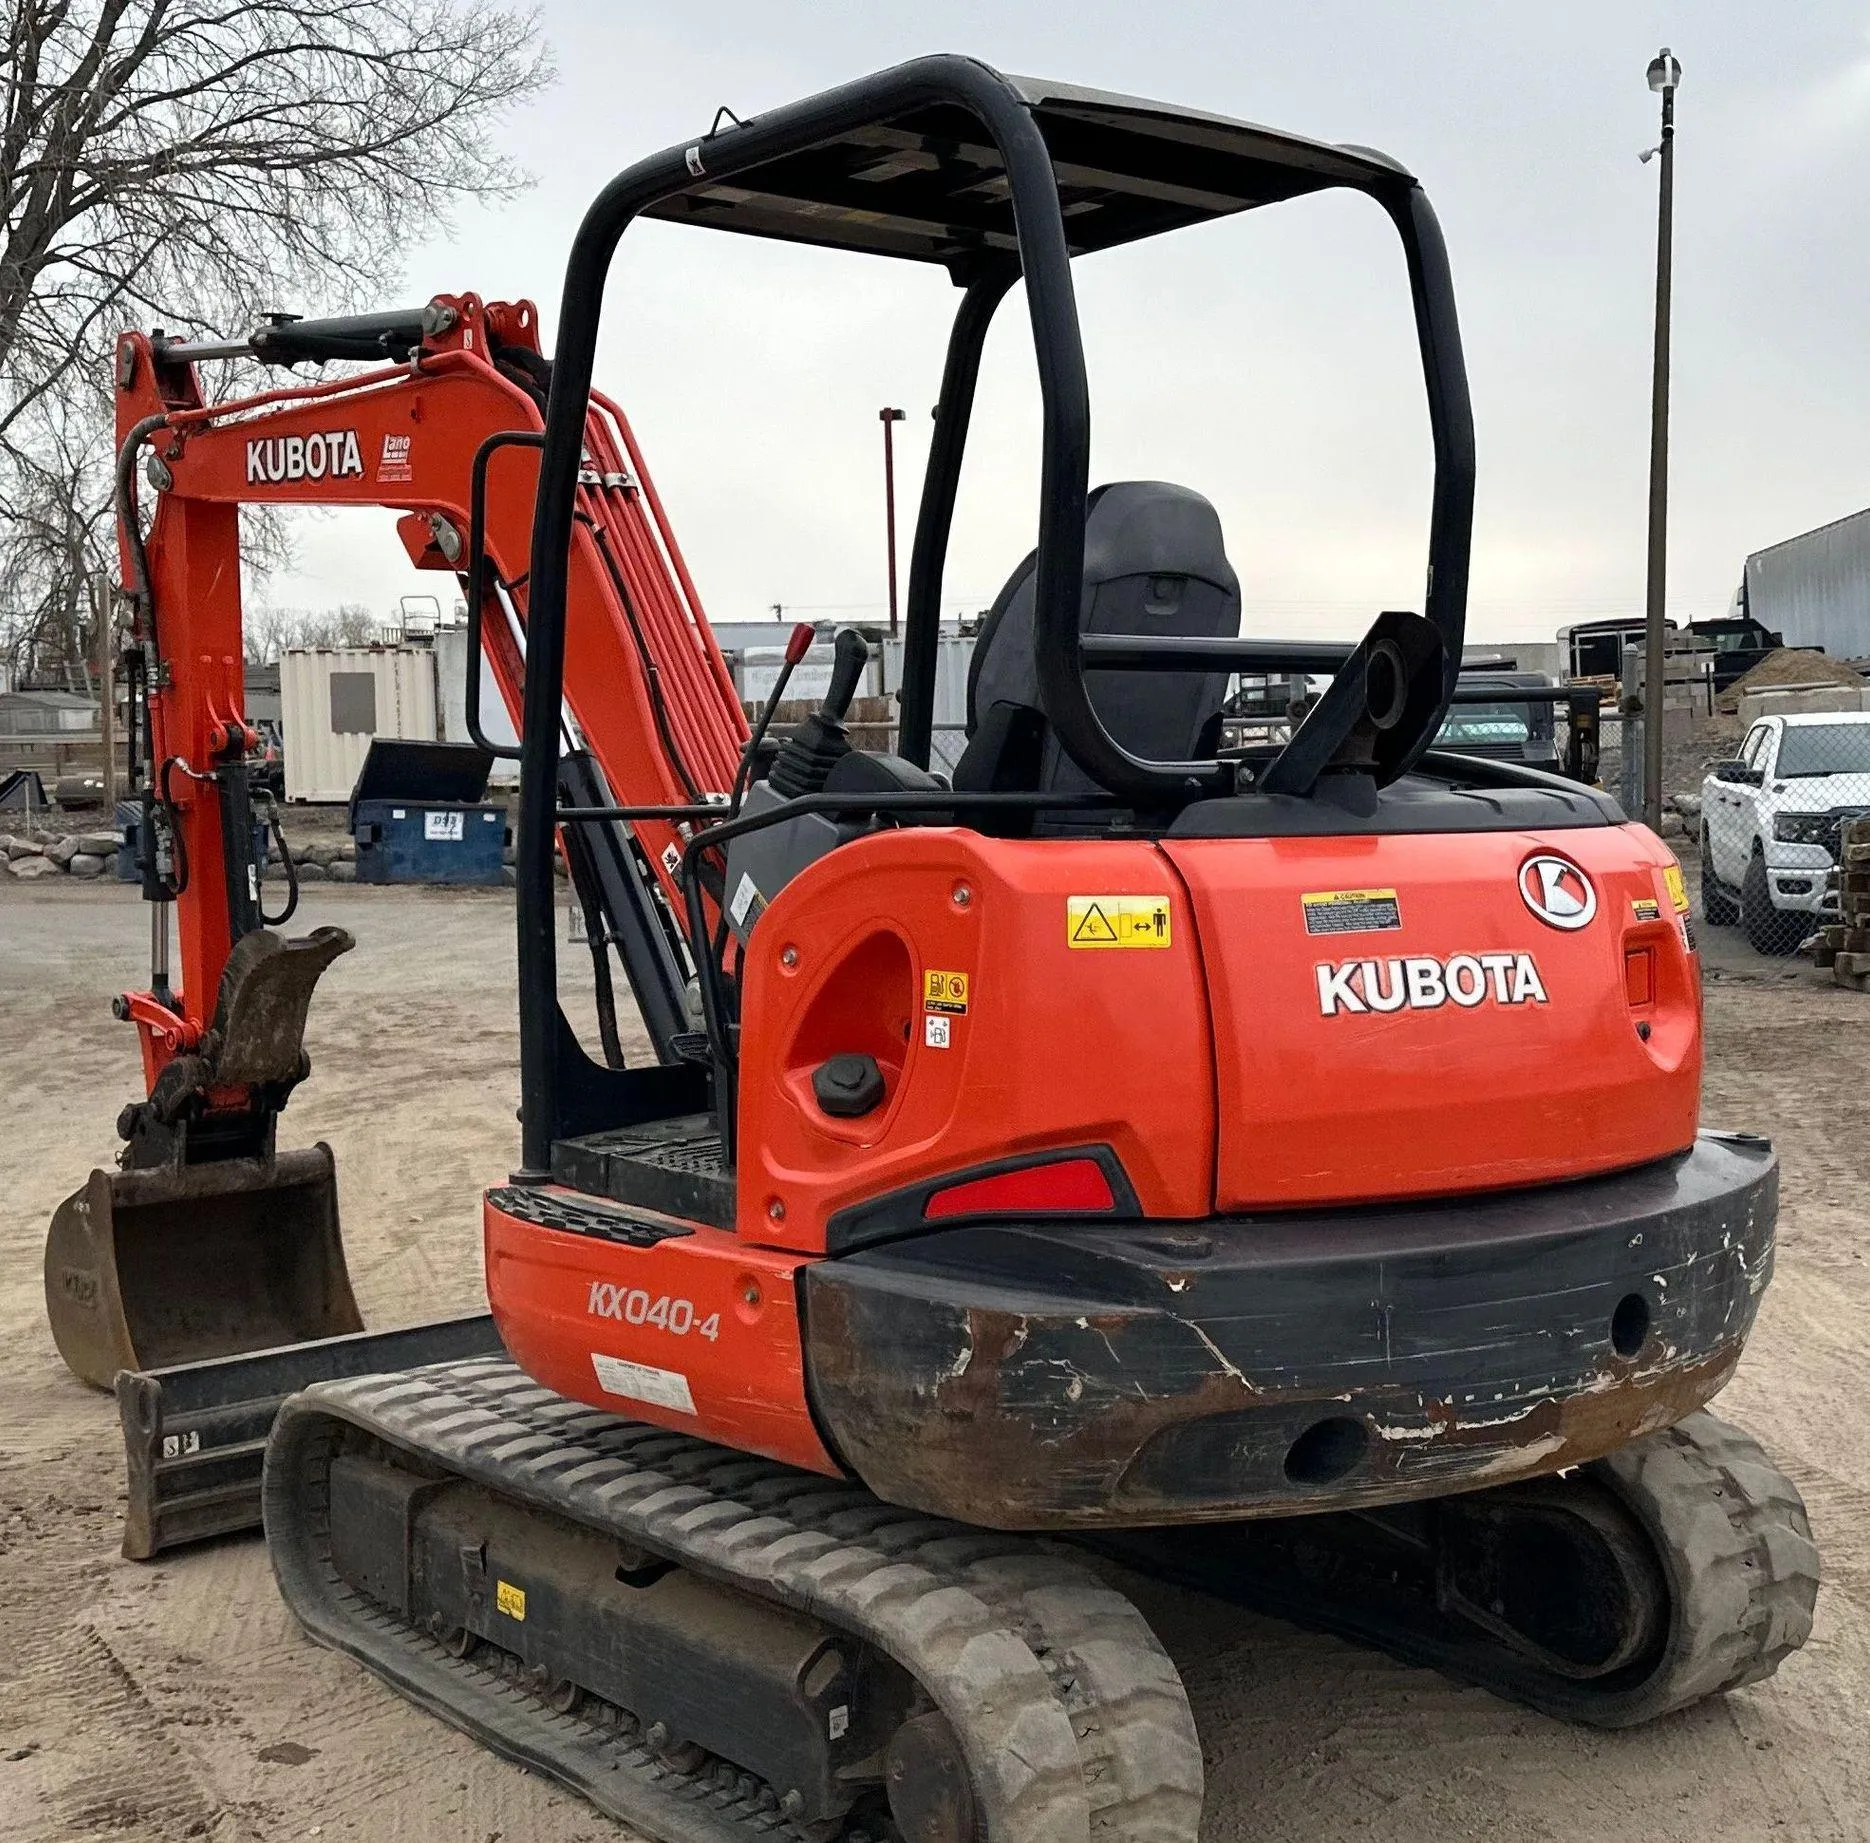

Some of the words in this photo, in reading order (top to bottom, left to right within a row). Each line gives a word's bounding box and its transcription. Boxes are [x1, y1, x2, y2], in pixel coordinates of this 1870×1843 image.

[247, 430, 363, 482] KUBOTA
[1315, 954, 1549, 1017] KUBOTA
[587, 1281, 721, 1342] KX040-4
